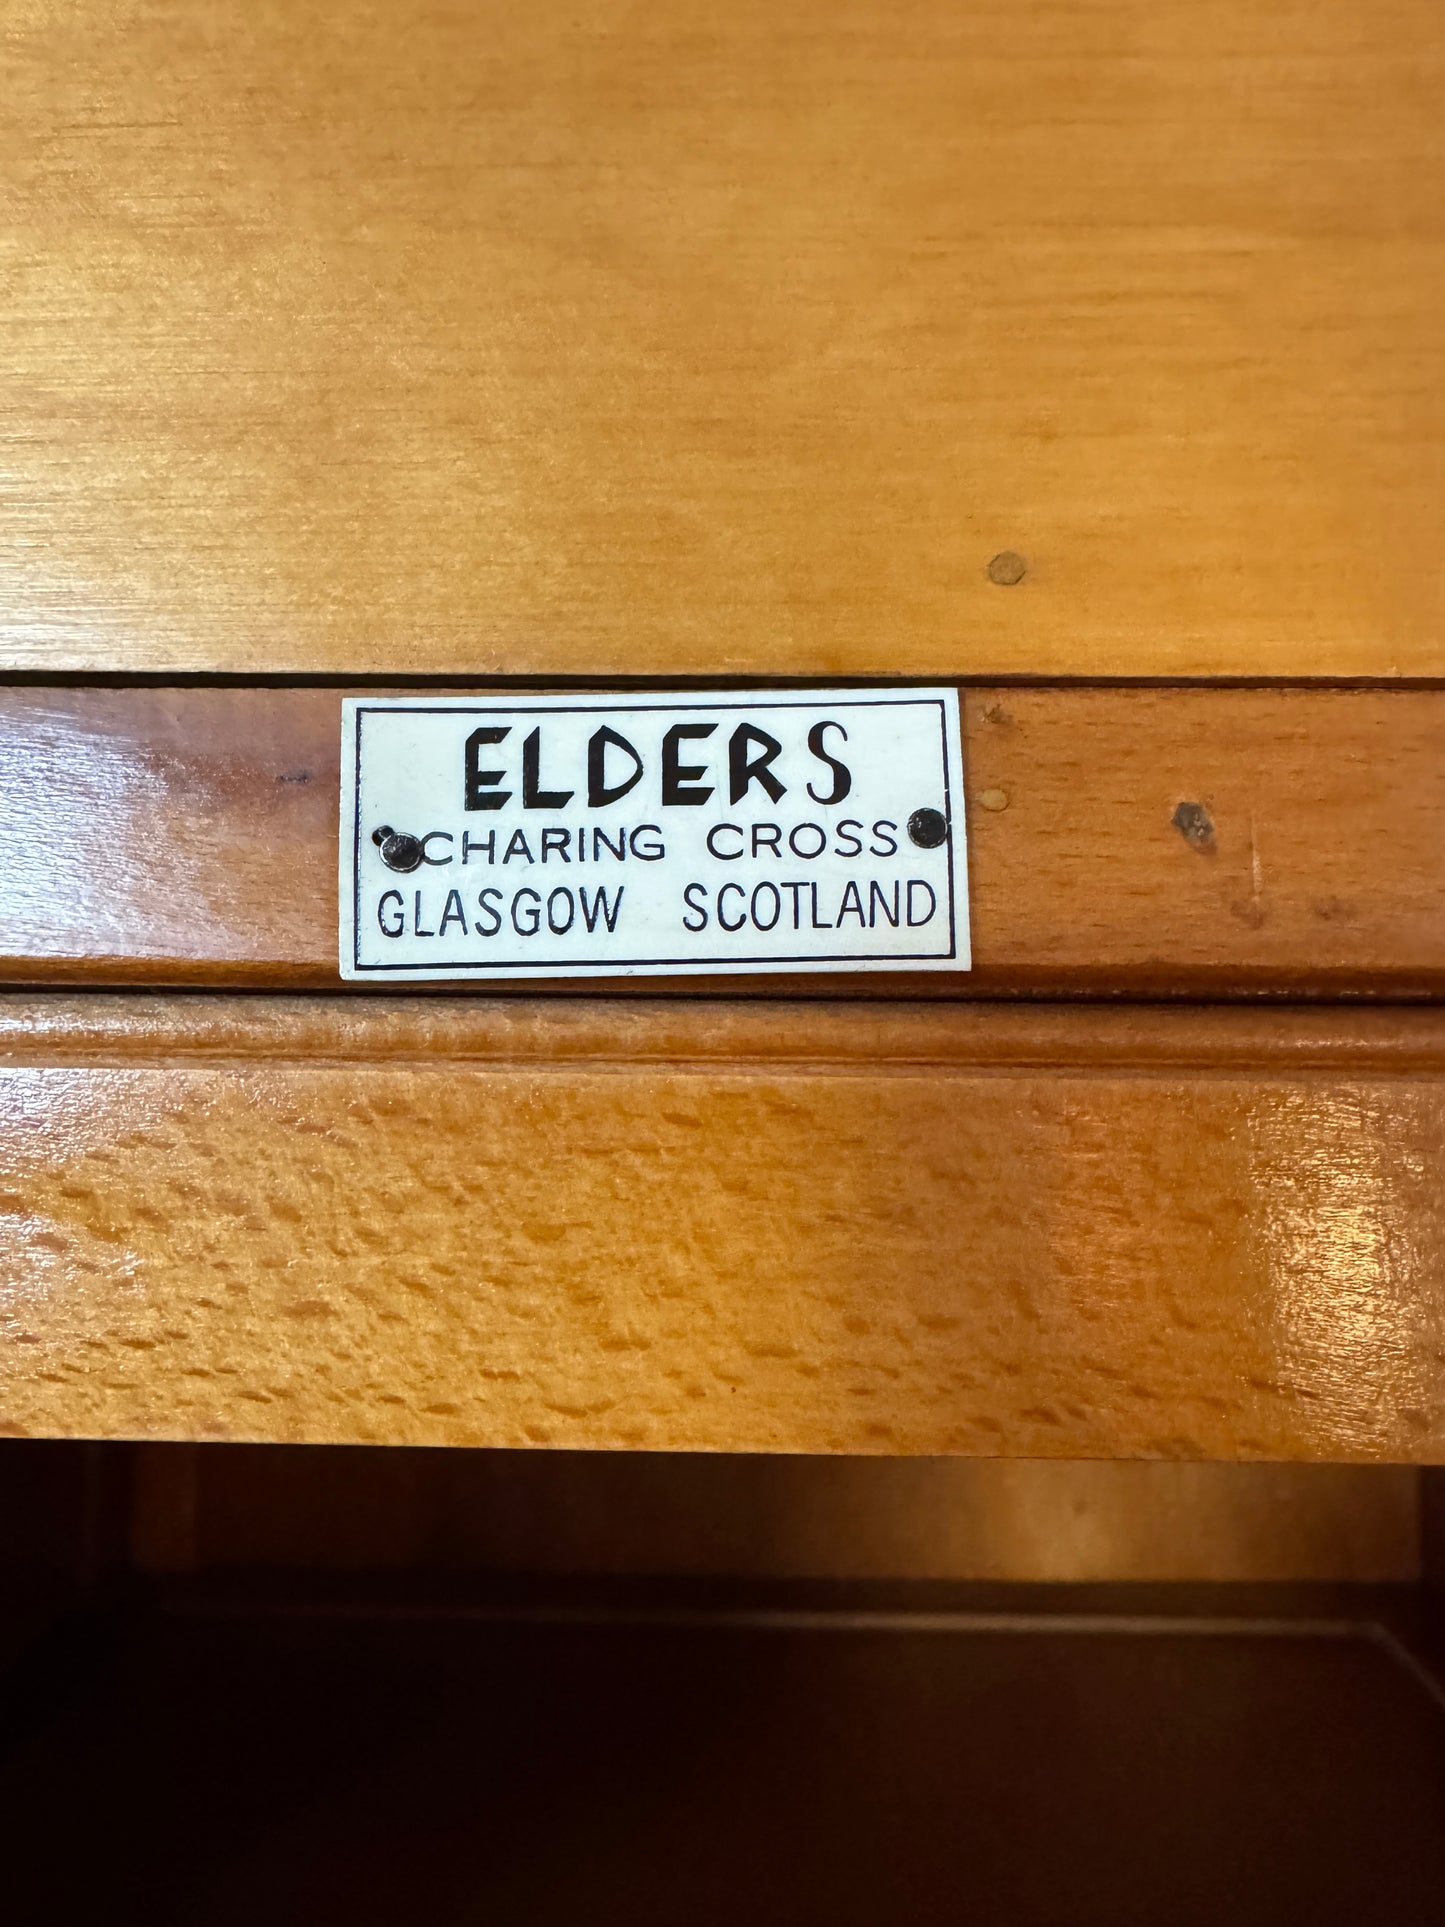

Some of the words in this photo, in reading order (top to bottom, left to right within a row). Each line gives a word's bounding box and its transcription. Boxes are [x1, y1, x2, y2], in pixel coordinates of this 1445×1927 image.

[464, 720, 853, 811] ELDERS
[420, 824, 666, 865] CHARING
[707, 819, 898, 861] CROSS
[377, 885, 625, 938] GLASGOW
[682, 878, 937, 932] SCOTLAND
